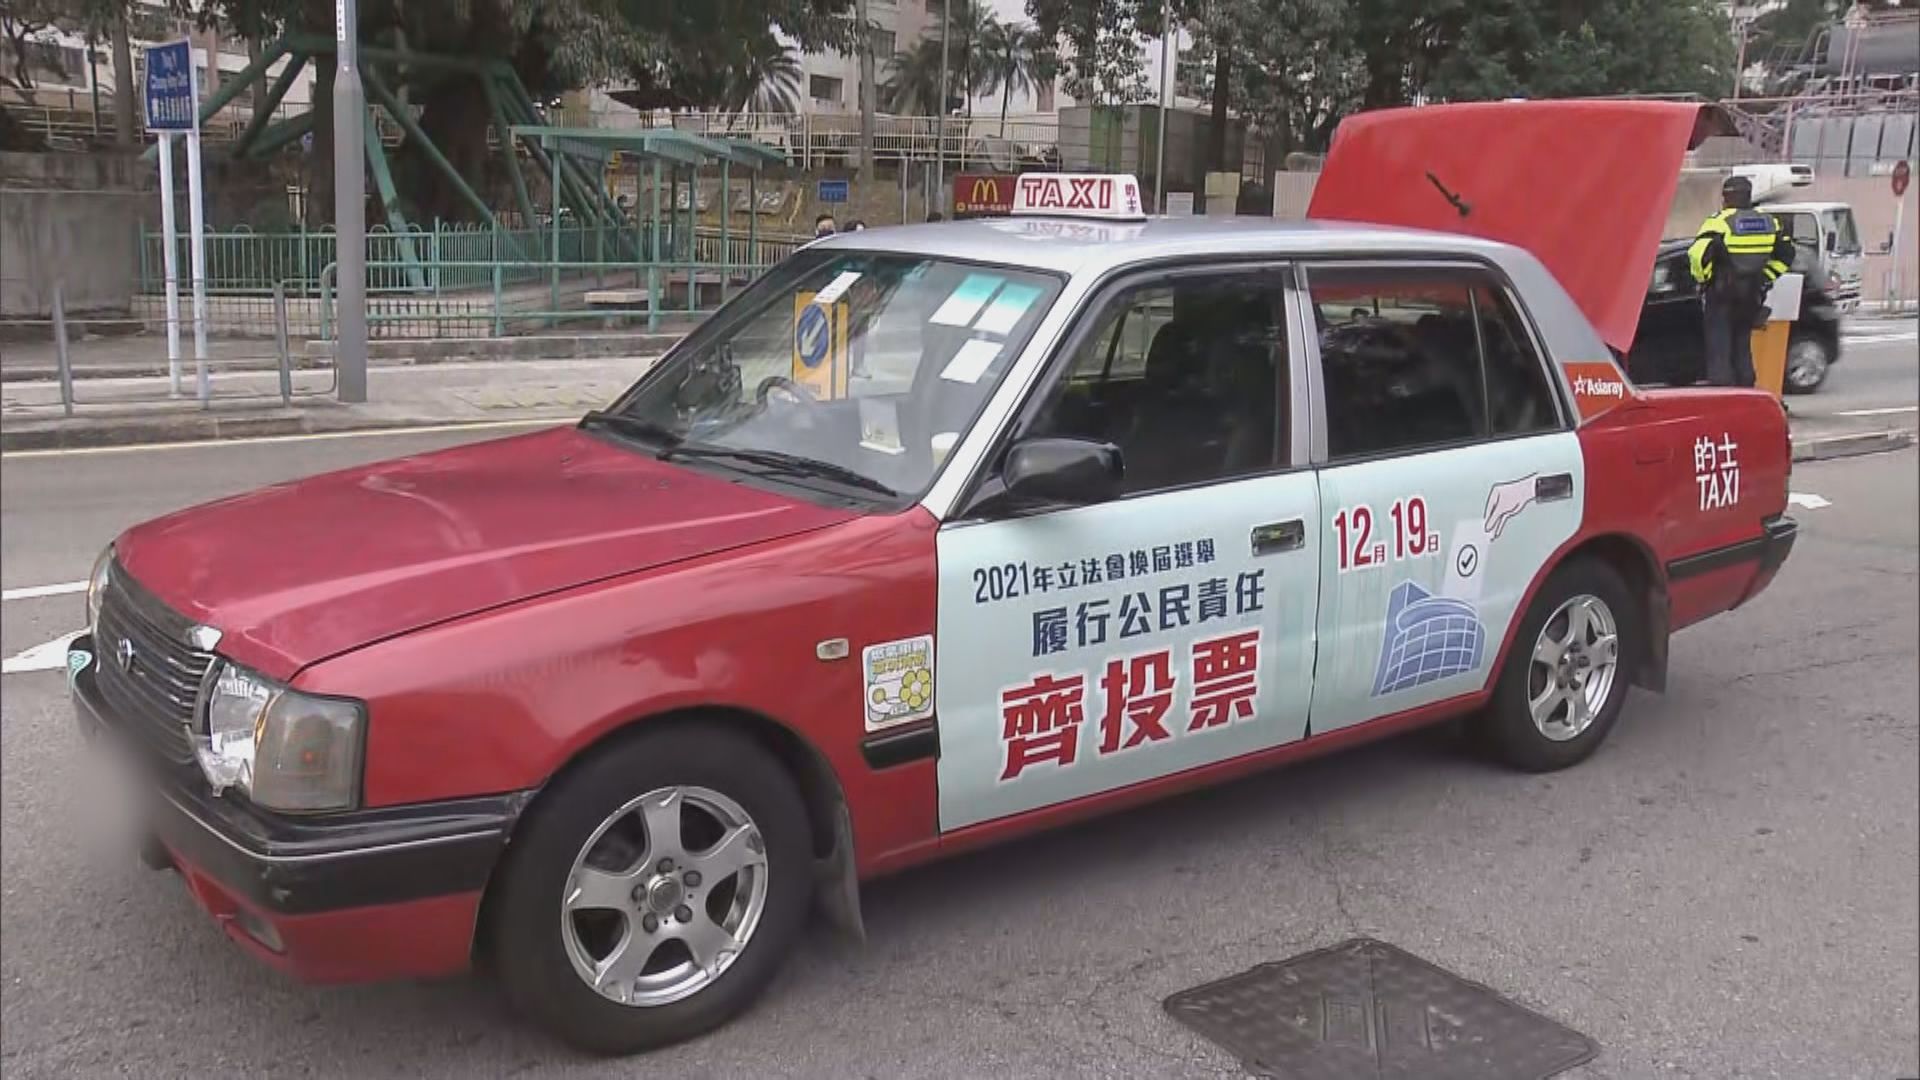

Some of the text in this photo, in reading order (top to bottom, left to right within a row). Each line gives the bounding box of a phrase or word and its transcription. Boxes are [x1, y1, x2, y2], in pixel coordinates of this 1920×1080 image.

[1022, 178, 1113, 209] TAXI
[1587, 377, 1624, 400] Asiaray
[1694, 431, 1738, 473] 的士
[1695, 467, 1740, 512] TAXI
[1032, 568, 1265, 657] 履行公民責任
[999, 628, 1262, 782] 齊投票
